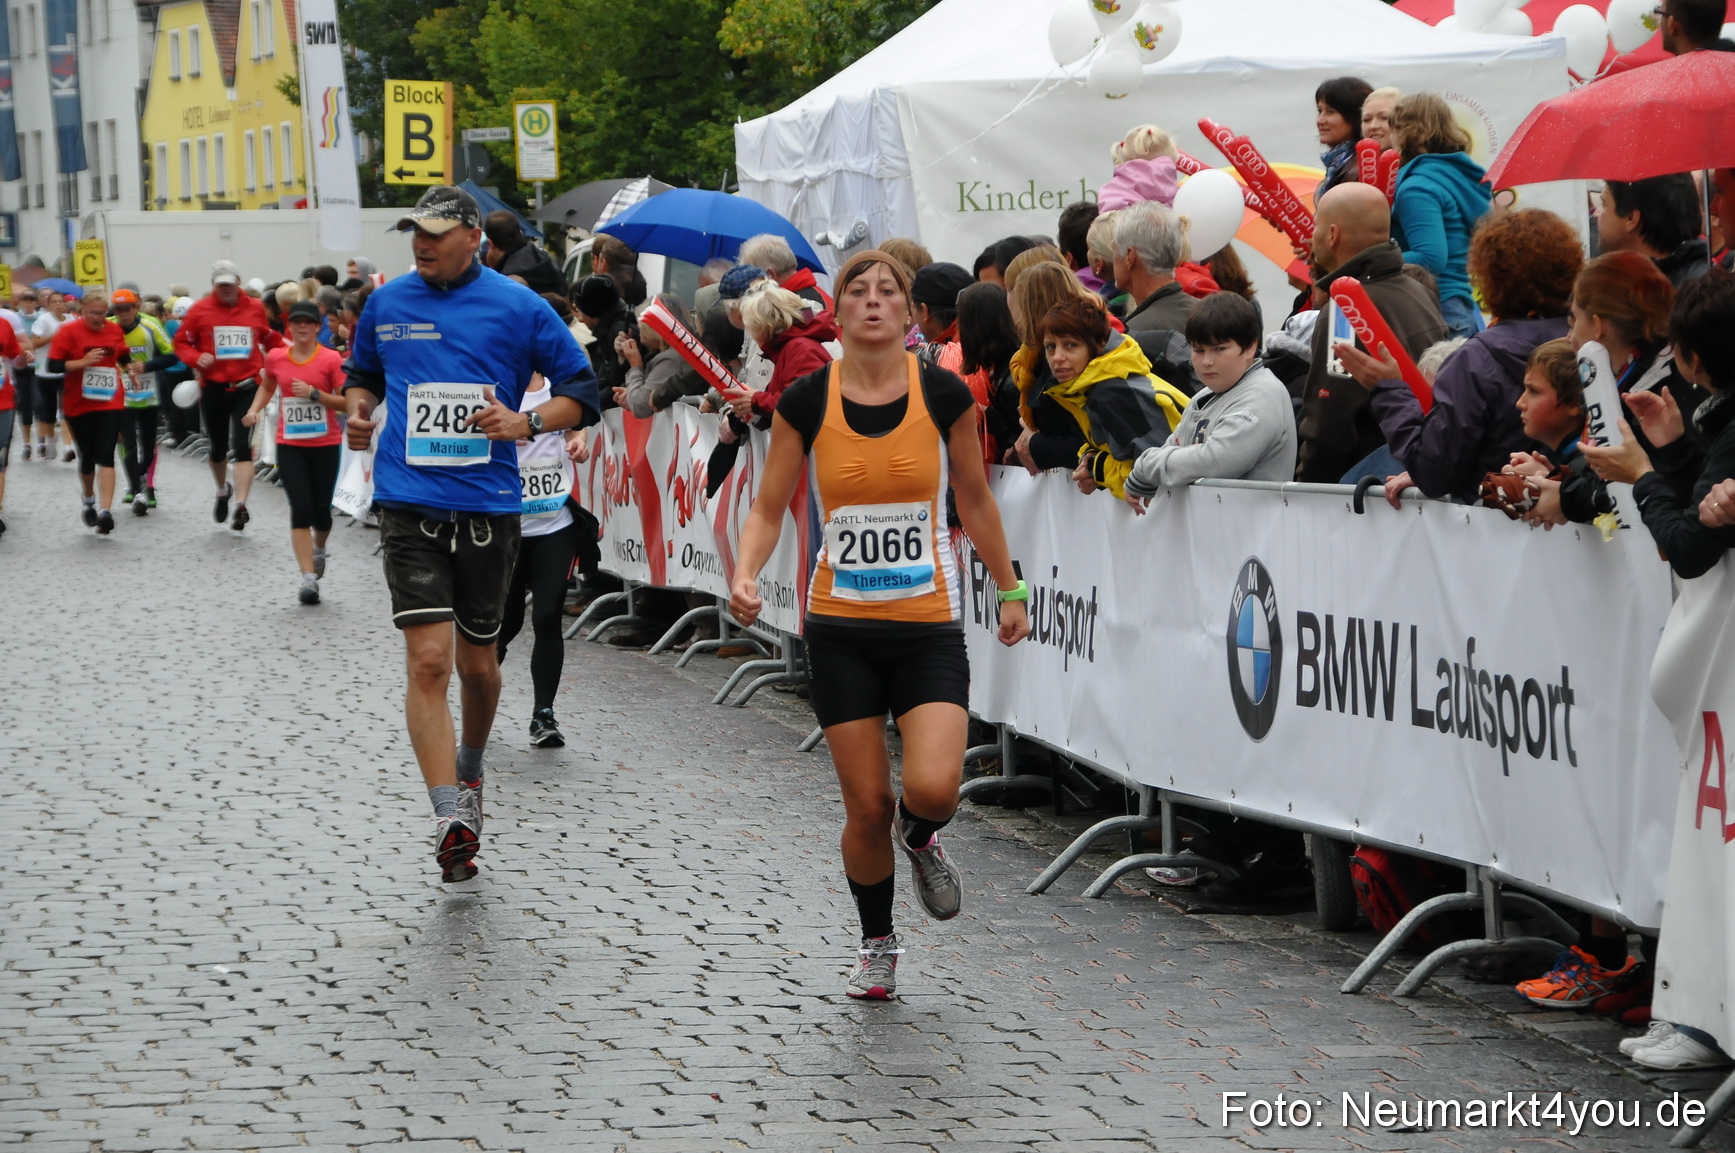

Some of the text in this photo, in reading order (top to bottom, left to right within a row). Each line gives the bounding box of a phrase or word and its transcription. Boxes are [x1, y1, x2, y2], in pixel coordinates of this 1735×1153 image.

[393, 85, 444, 104] Block
[182, 105, 204, 130] HOTEL
[1445, 91, 1499, 154] EINSAMEN KINDERN
[403, 112, 435, 161] B
[957, 179, 1069, 212] Kinder
[75, 241, 100, 251] Block
[81, 253, 97, 275] C
[218, 333, 248, 346] 2176
[86, 373, 114, 388] 2733
[409, 391, 480, 400] PARTL Neumarkt
[287, 405, 322, 422] 2043
[430, 441, 469, 454] Marius
[530, 464, 557, 472] Neumarkt
[864, 512, 914, 524] Neumarkt
[838, 525, 922, 564] 2066
[852, 571, 912, 588] Theresia
[1232, 563, 1277, 622] BMW
[1296, 610, 1578, 777] BMW Laufsport
